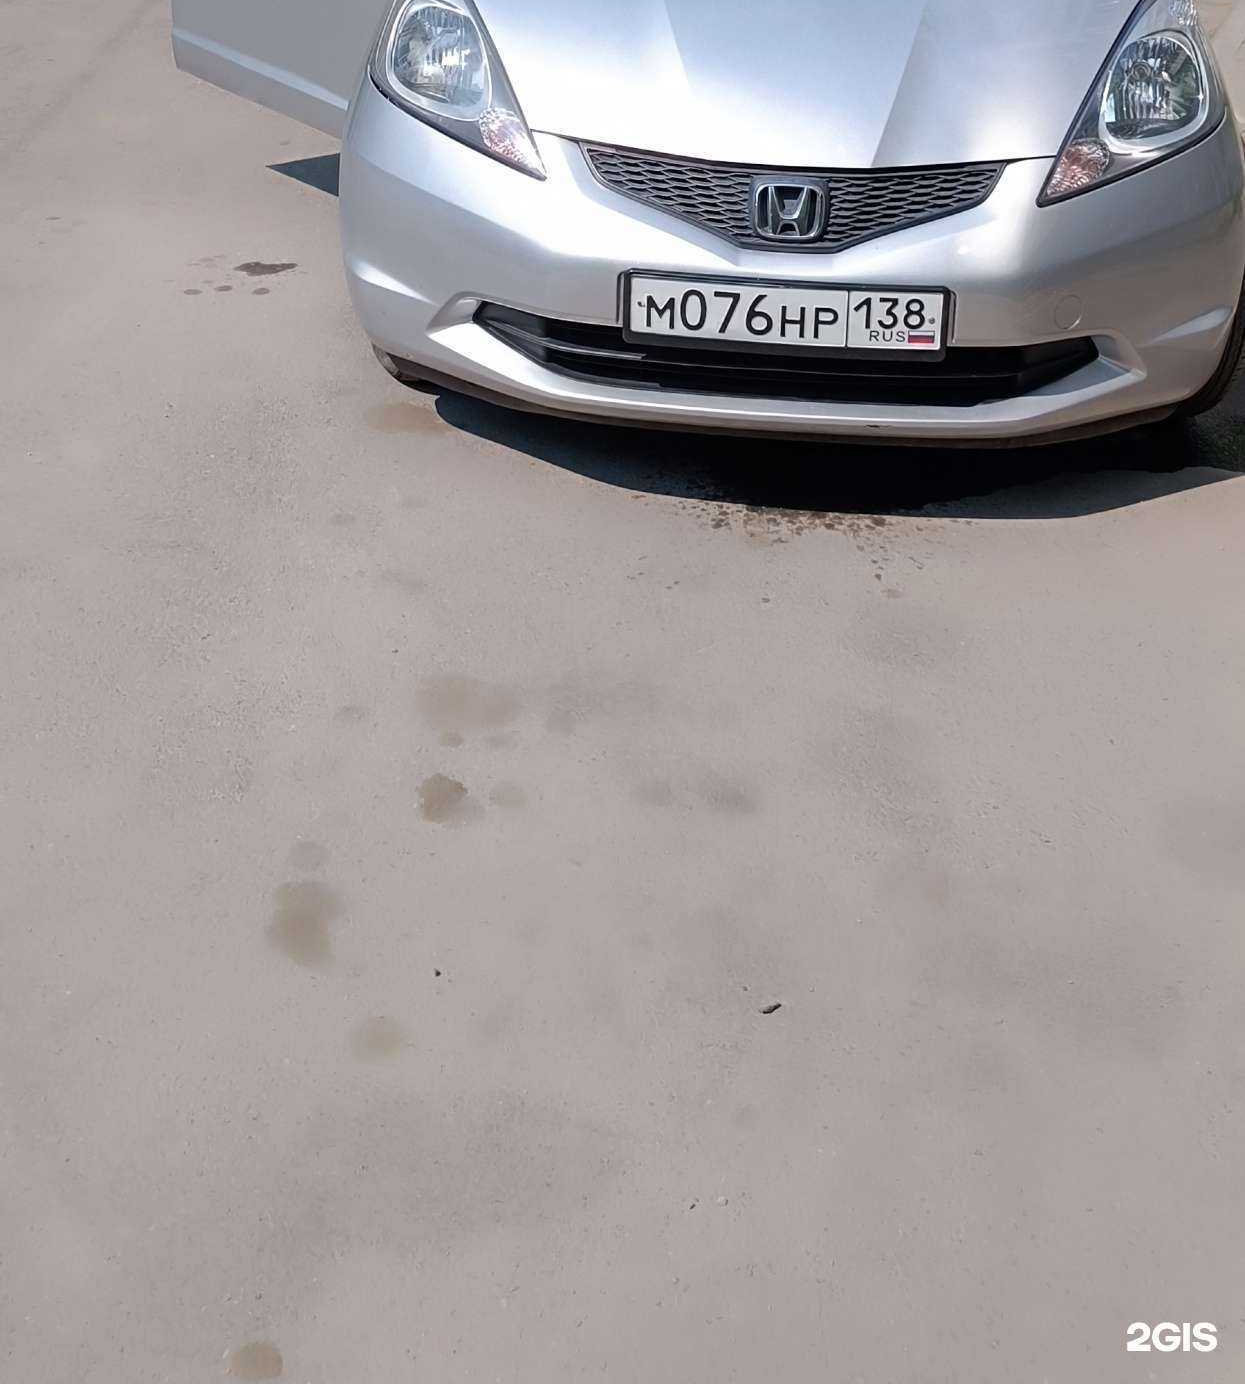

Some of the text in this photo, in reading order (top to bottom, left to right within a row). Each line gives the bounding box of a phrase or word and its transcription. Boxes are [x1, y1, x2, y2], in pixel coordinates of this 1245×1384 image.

[646, 289, 926, 339] М076НР 138
[868, 330, 905, 343] RUS
